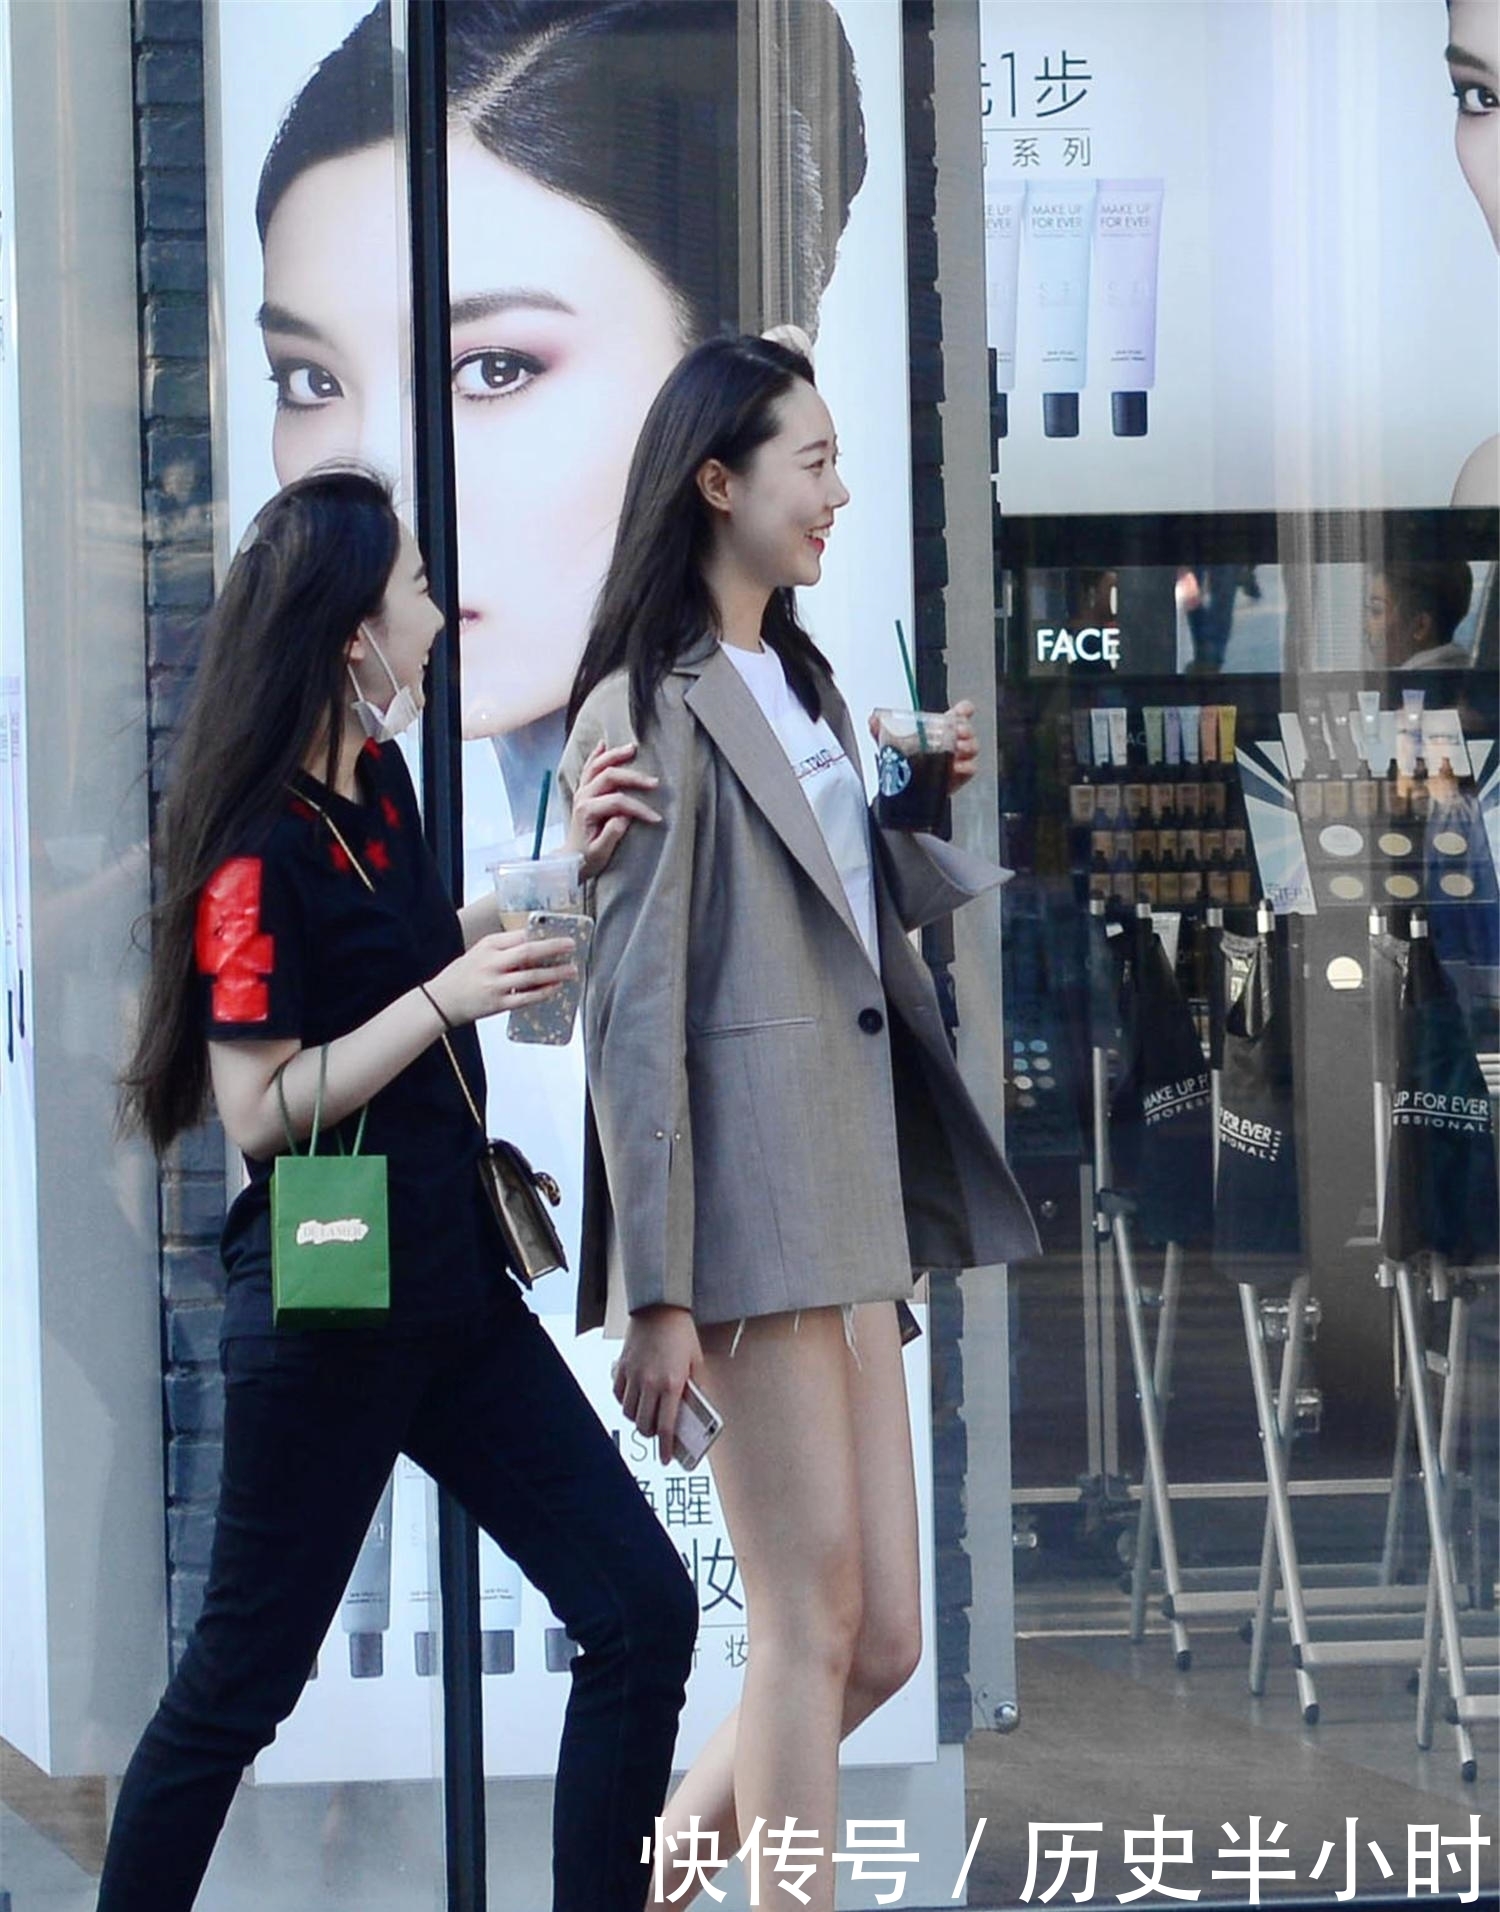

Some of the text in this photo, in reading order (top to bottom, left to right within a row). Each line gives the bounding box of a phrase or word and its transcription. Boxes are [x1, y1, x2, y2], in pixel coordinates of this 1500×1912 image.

[1032, 203, 1082, 215] MAKE UP
[1101, 202, 1151, 215] MAKE UP
[1032, 216, 1082, 228] FOR EVER
[1101, 216, 1152, 228] FOR EVER
[1037, 628, 1120, 662] FACE
[1143, 1085, 1174, 1109] MAKE
[1176, 1077, 1195, 1095] UP
[1413, 1091, 1447, 1111] FOR
[1451, 1096, 1489, 1115] EVER
[1240, 1119, 1272, 1142] EVER
